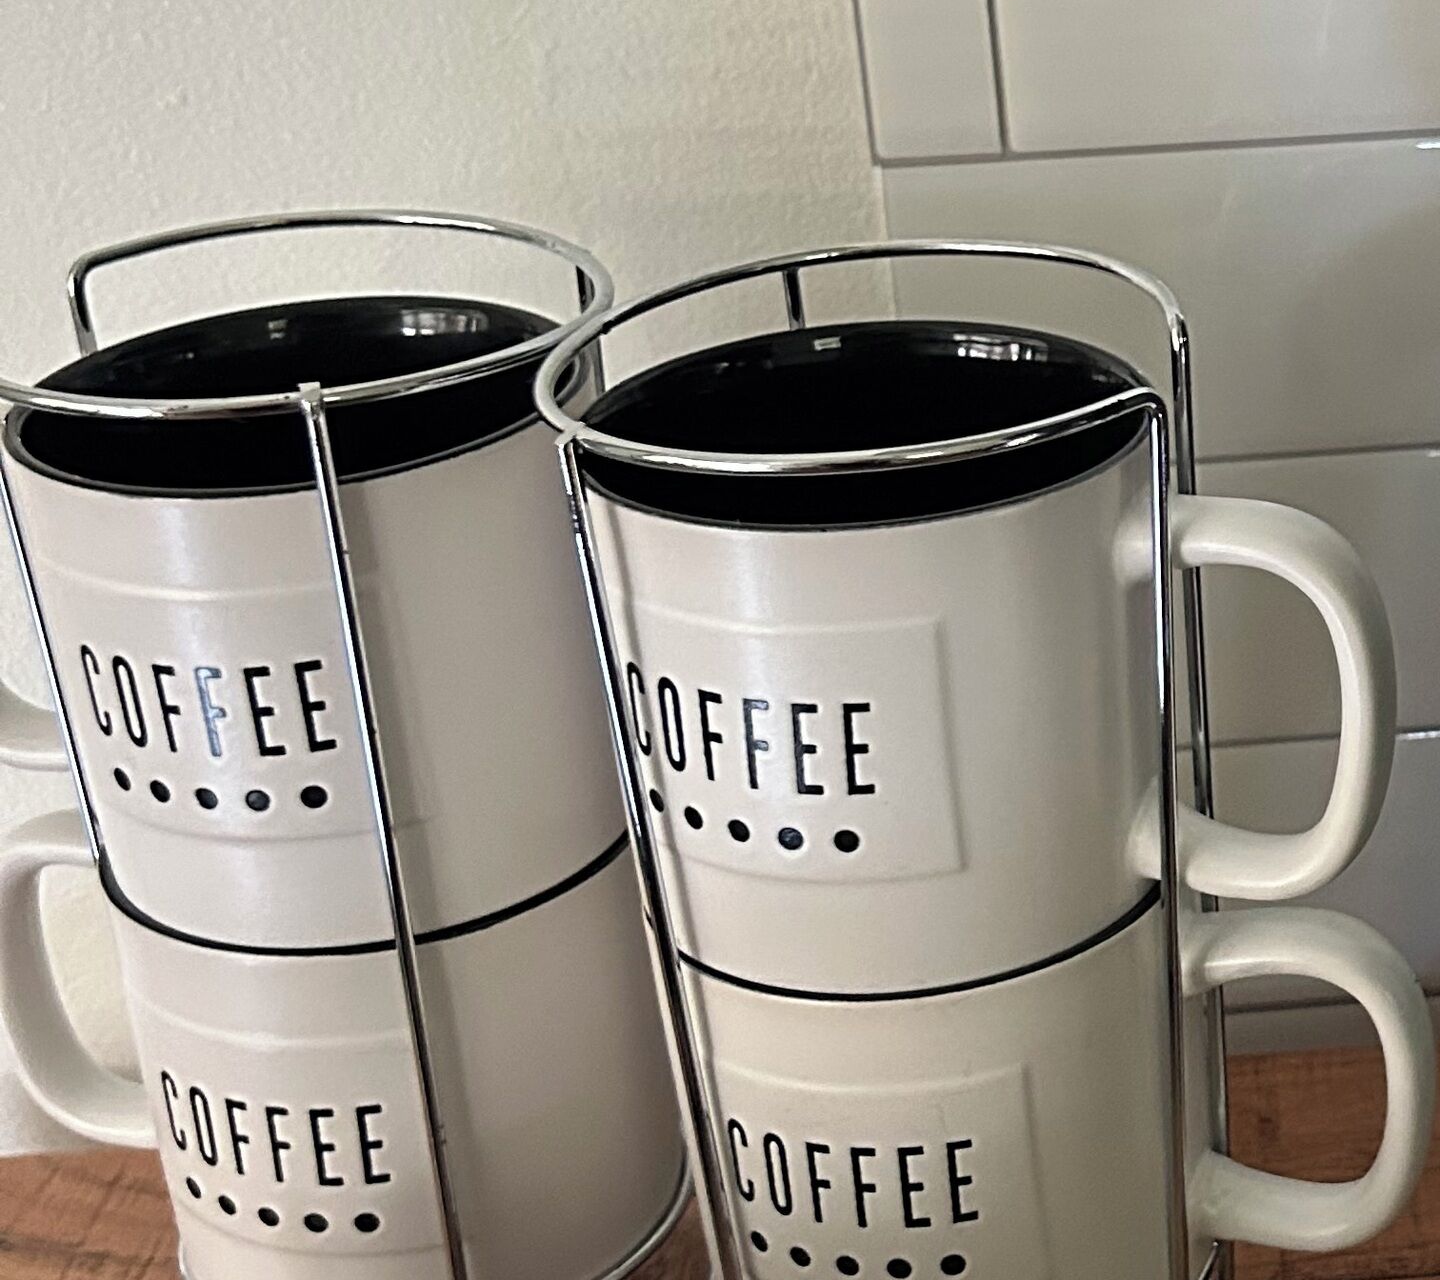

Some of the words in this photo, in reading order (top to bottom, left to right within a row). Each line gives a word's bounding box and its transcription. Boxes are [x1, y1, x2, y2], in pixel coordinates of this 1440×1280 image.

[80, 644, 337, 757] COFFEE
[626, 662, 876, 796] COFFEE
[160, 1070, 391, 1186] COFFEE
[727, 1118, 979, 1229] COFFEE
